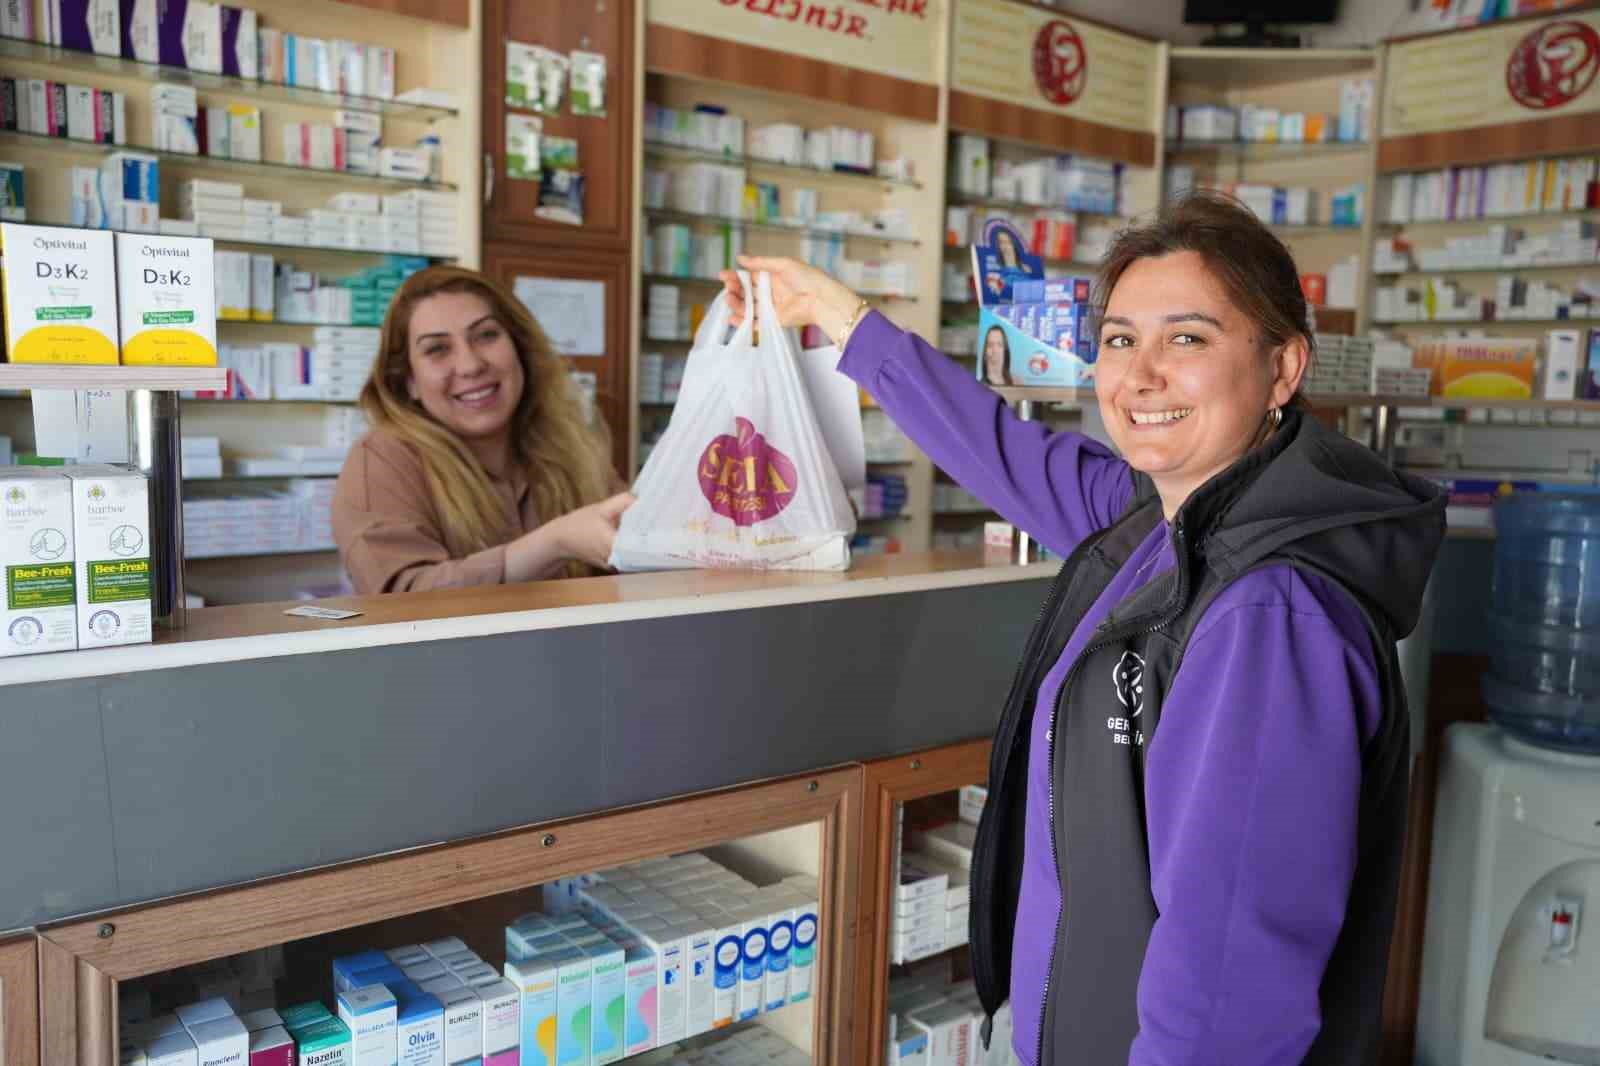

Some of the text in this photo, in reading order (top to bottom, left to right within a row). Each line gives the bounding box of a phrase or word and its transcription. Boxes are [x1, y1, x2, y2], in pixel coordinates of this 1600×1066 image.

[33, 236, 87, 251] Optivital
[141, 245, 191, 258] Optivital
[15, 565, 73, 579] Bee-Fresh
[94, 561, 149, 574] Bee-Fresh
[408, 1031, 436, 1046] Olvin
[306, 1048, 344, 1065] Nazetin
